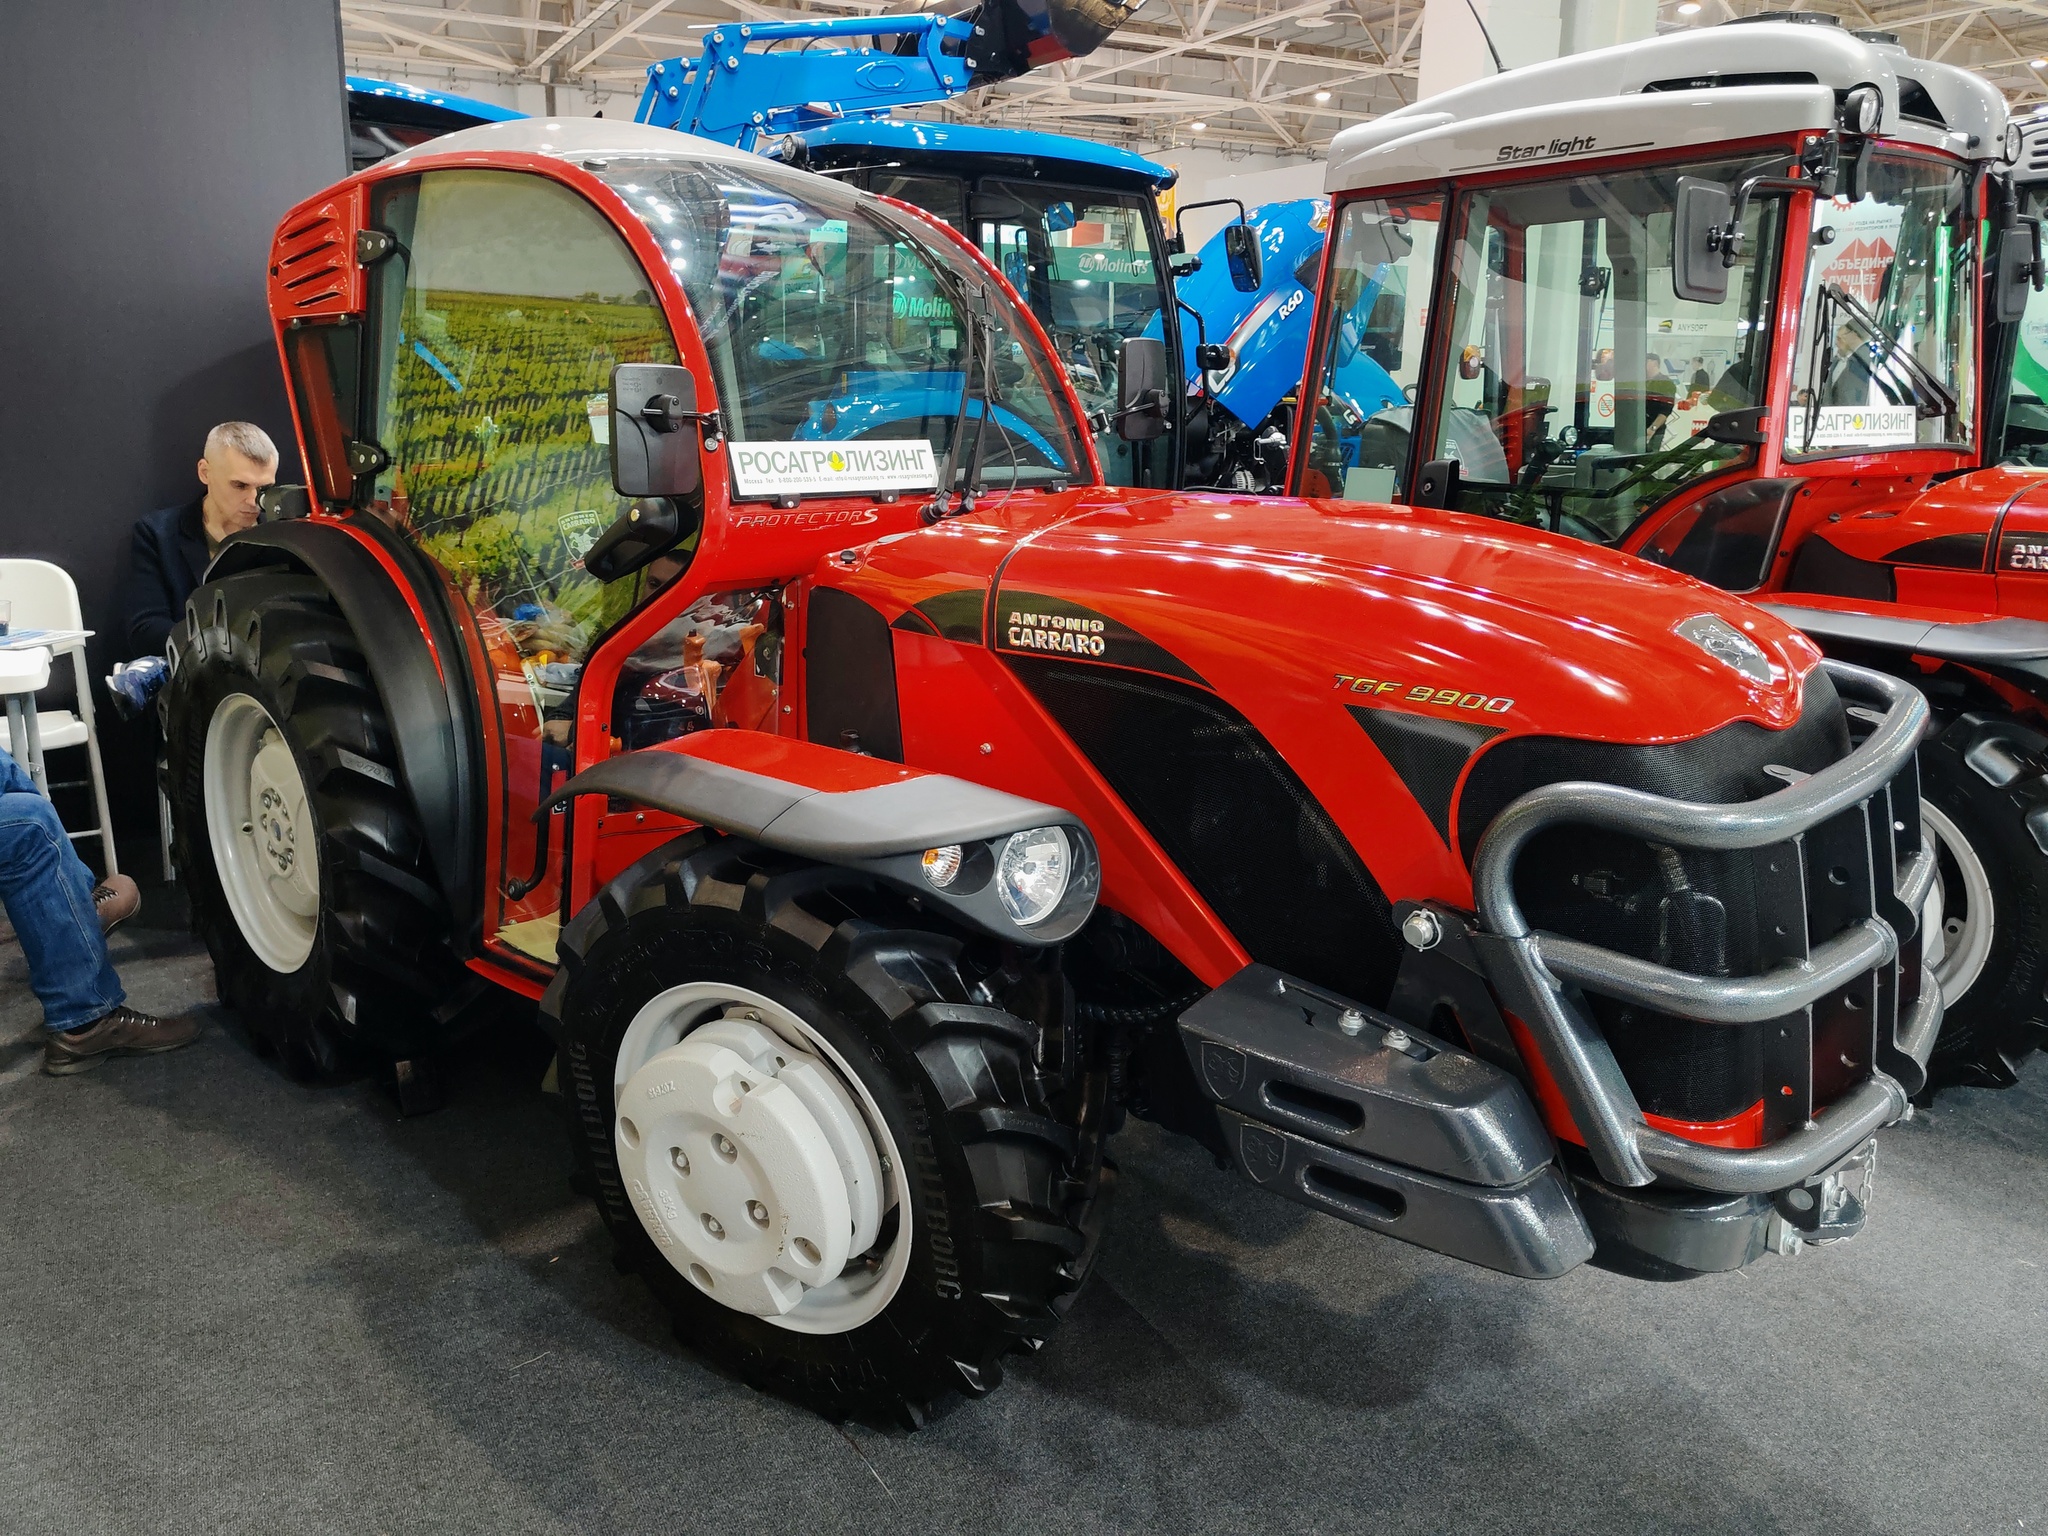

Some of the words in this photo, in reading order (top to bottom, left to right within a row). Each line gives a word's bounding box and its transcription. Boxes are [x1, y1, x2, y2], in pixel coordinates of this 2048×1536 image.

[1496, 146, 1545, 162] Star
[1547, 136, 1597, 157] light
[1278, 289, 1305, 321] R60
[1677, 323, 1708, 332] ANYSORT
[738, 449, 927, 474] РОСАГРОЛИЗИНГ
[560, 513, 595, 525] ANTONIO
[1008, 611, 1105, 633] ANTONIO
[1008, 627, 1106, 657] CARRARO
[1332, 673, 1403, 696] TGF
[1404, 685, 1516, 714] 9900
